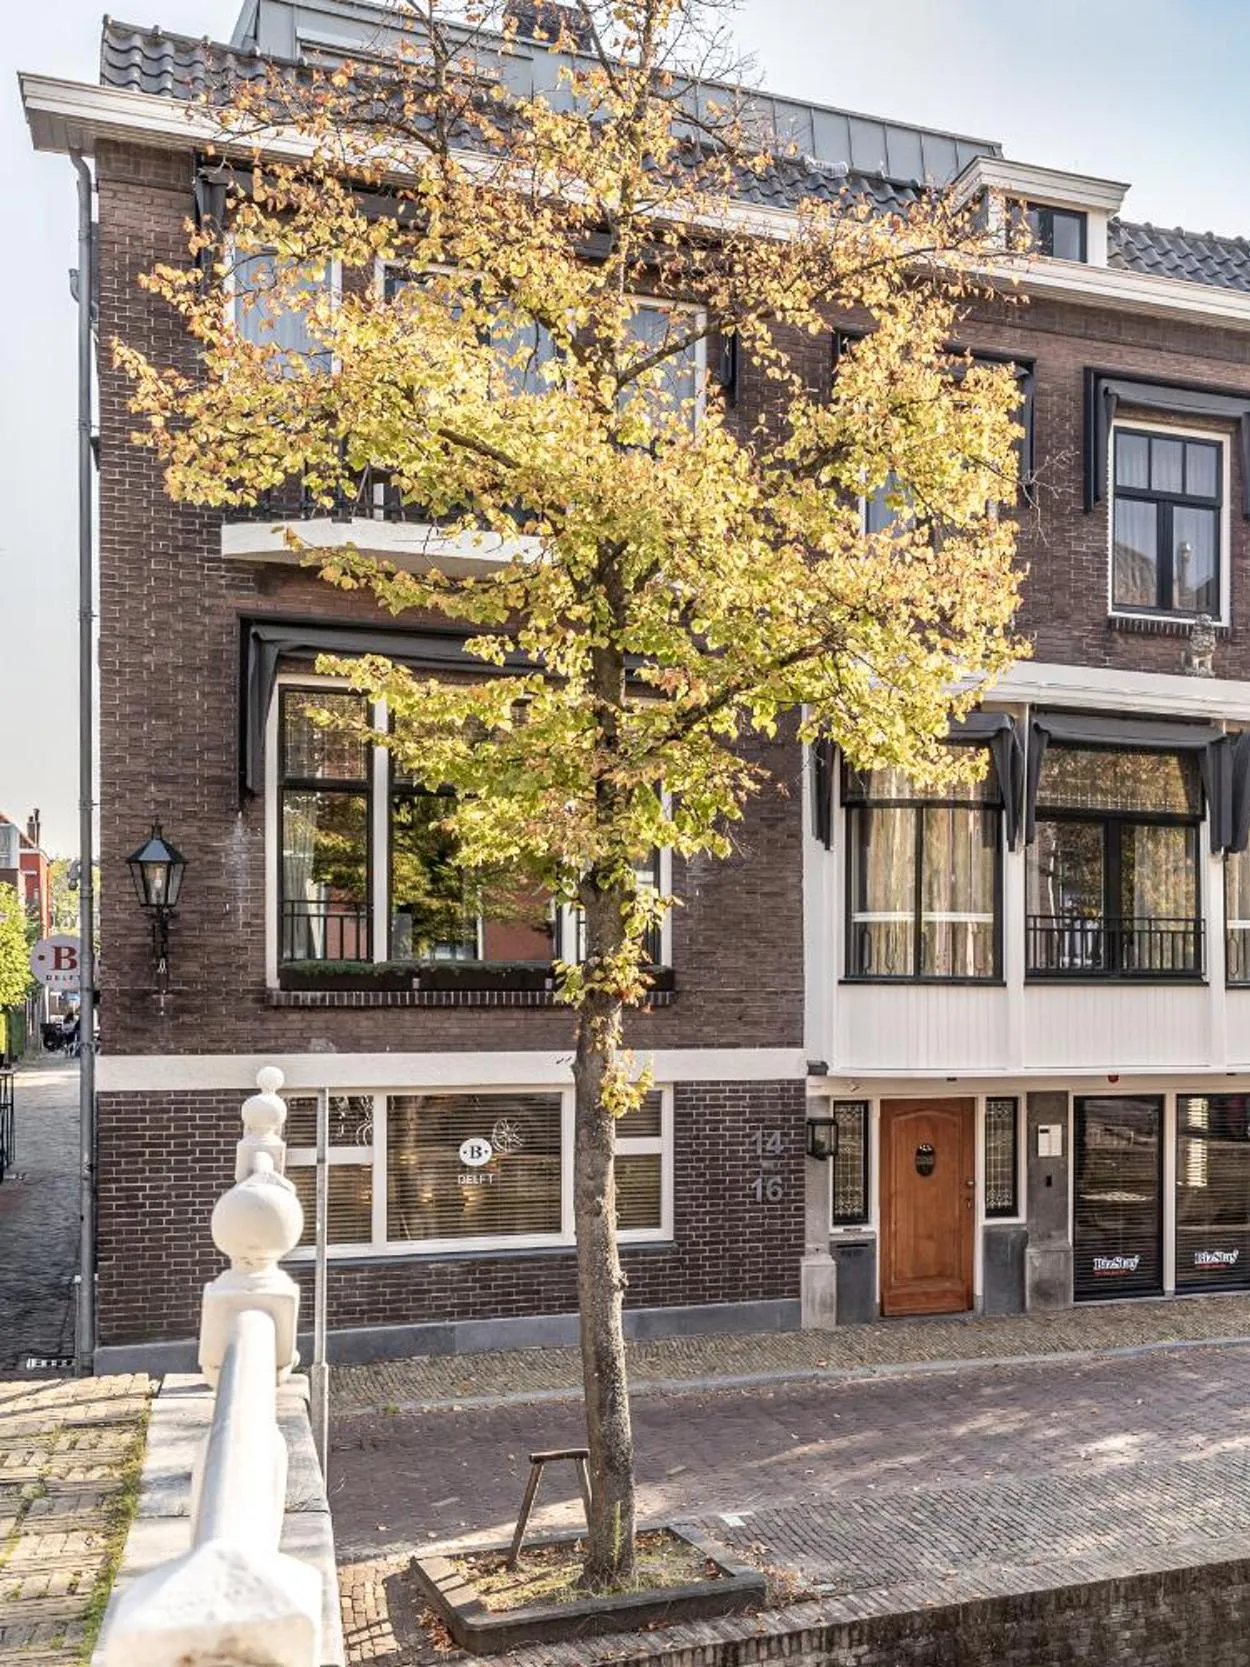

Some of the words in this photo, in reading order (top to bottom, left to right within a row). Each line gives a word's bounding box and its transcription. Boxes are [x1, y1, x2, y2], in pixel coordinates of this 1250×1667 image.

[751, 1130, 785, 1155] 14
[457, 1174, 495, 1184] DELFT
[751, 1176, 784, 1203] 16
